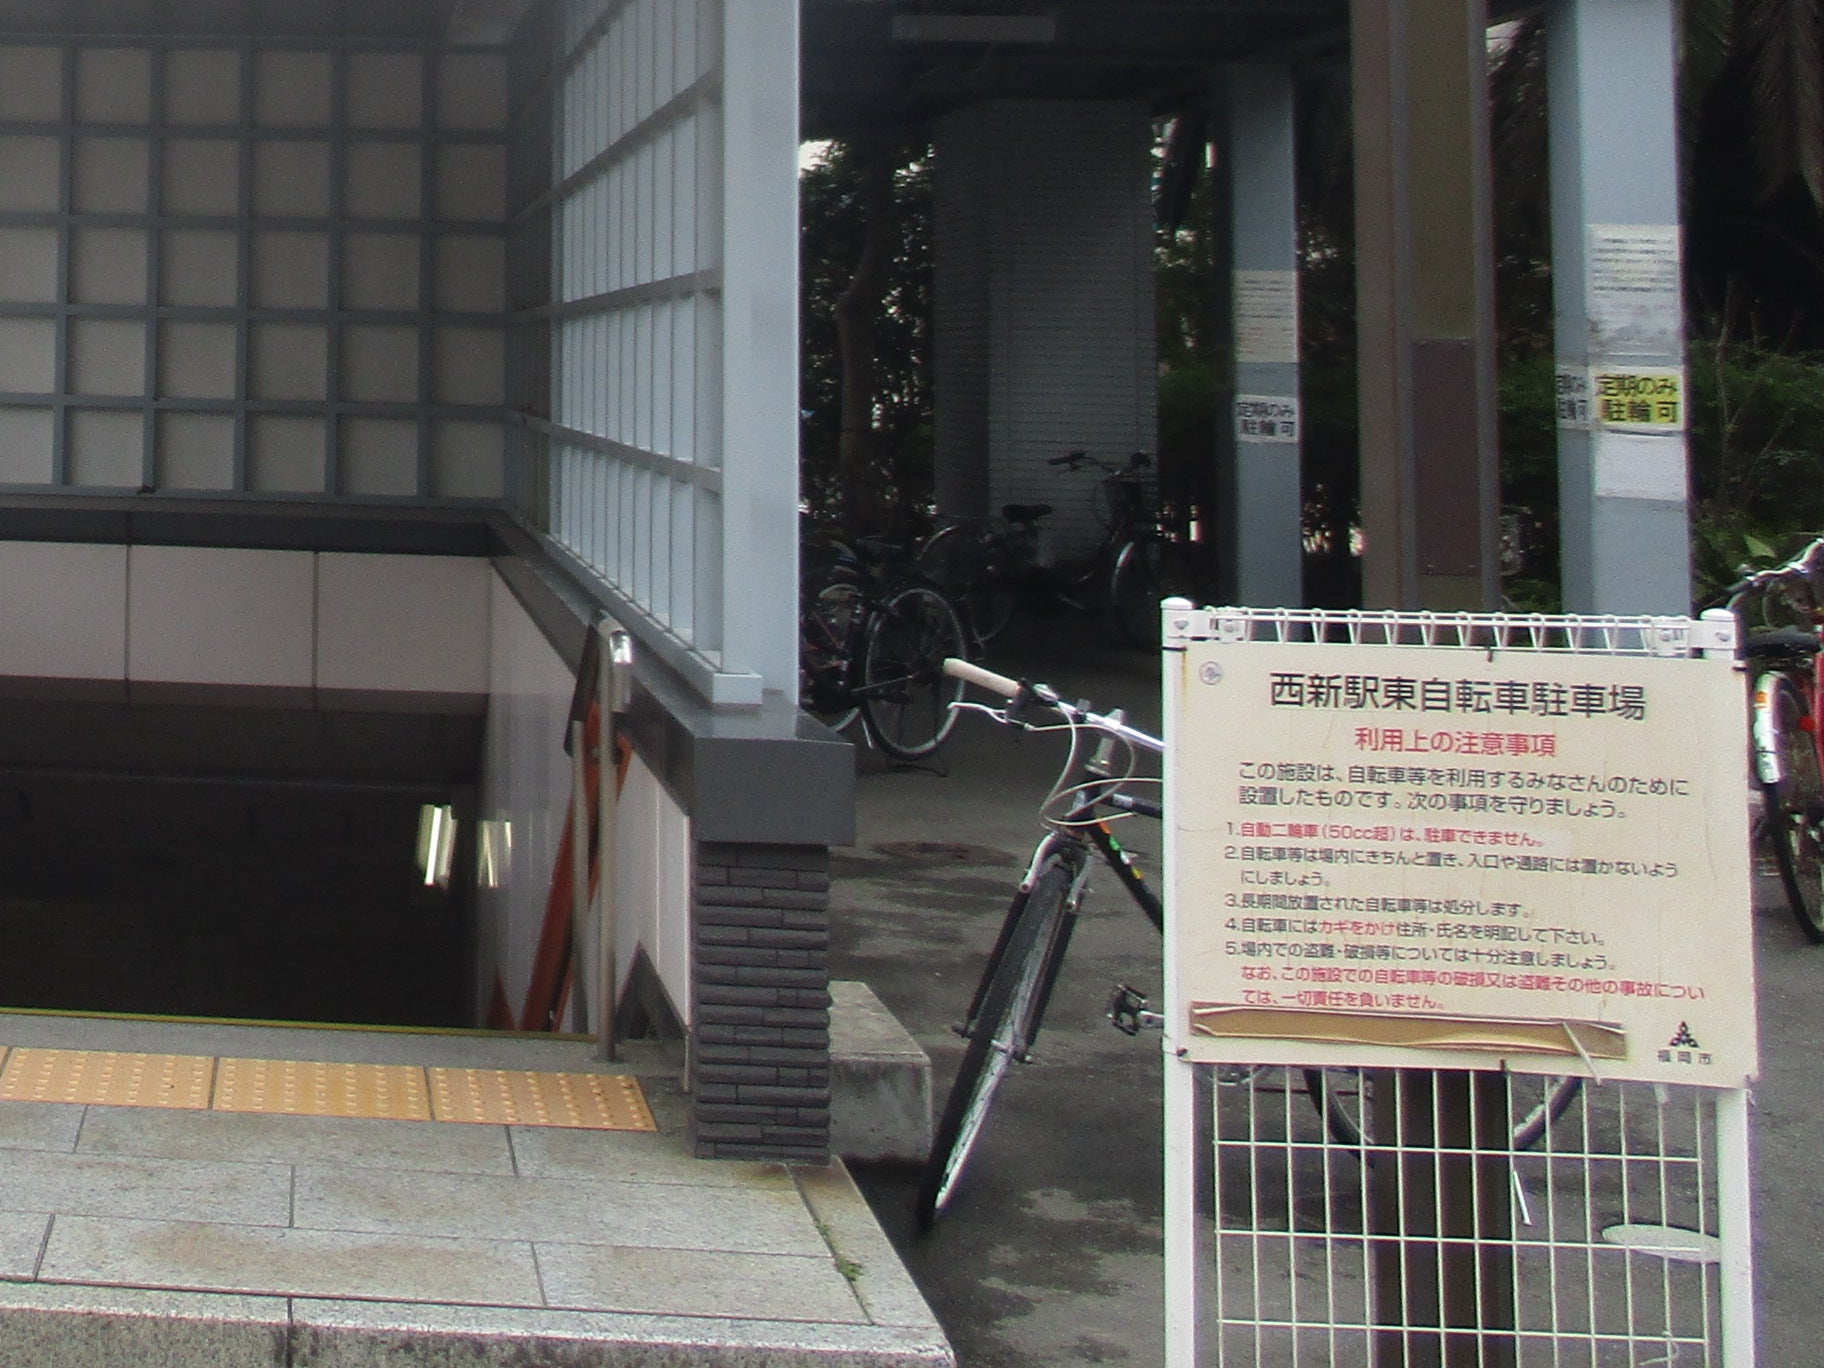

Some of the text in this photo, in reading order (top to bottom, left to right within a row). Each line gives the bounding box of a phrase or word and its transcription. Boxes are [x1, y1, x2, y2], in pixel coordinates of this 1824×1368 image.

[1594, 373, 1677, 397] 定期のみ
[1600, 398, 1679, 424] 駐輪可
[1269, 670, 1647, 721] 西新駅東自転車駐車場
[1354, 726, 1556, 758] 利用上の注意事項
[1239, 761, 1689, 796] この施設は、自転車等を利用するみなさんのために
[1239, 785, 1627, 819] 設置したものです。次の事項を守りましょう。
[1241, 870, 1331, 887] にしましょう。
[1224, 892, 1533, 919] 3.長期間放置された自転車等は処分します。
[1241, 965, 1706, 1001] なお、この施設での自転車等の破損又は盗難その他の事故につい
[1242, 988, 1446, 1010] ては、一切責任を負いません。
